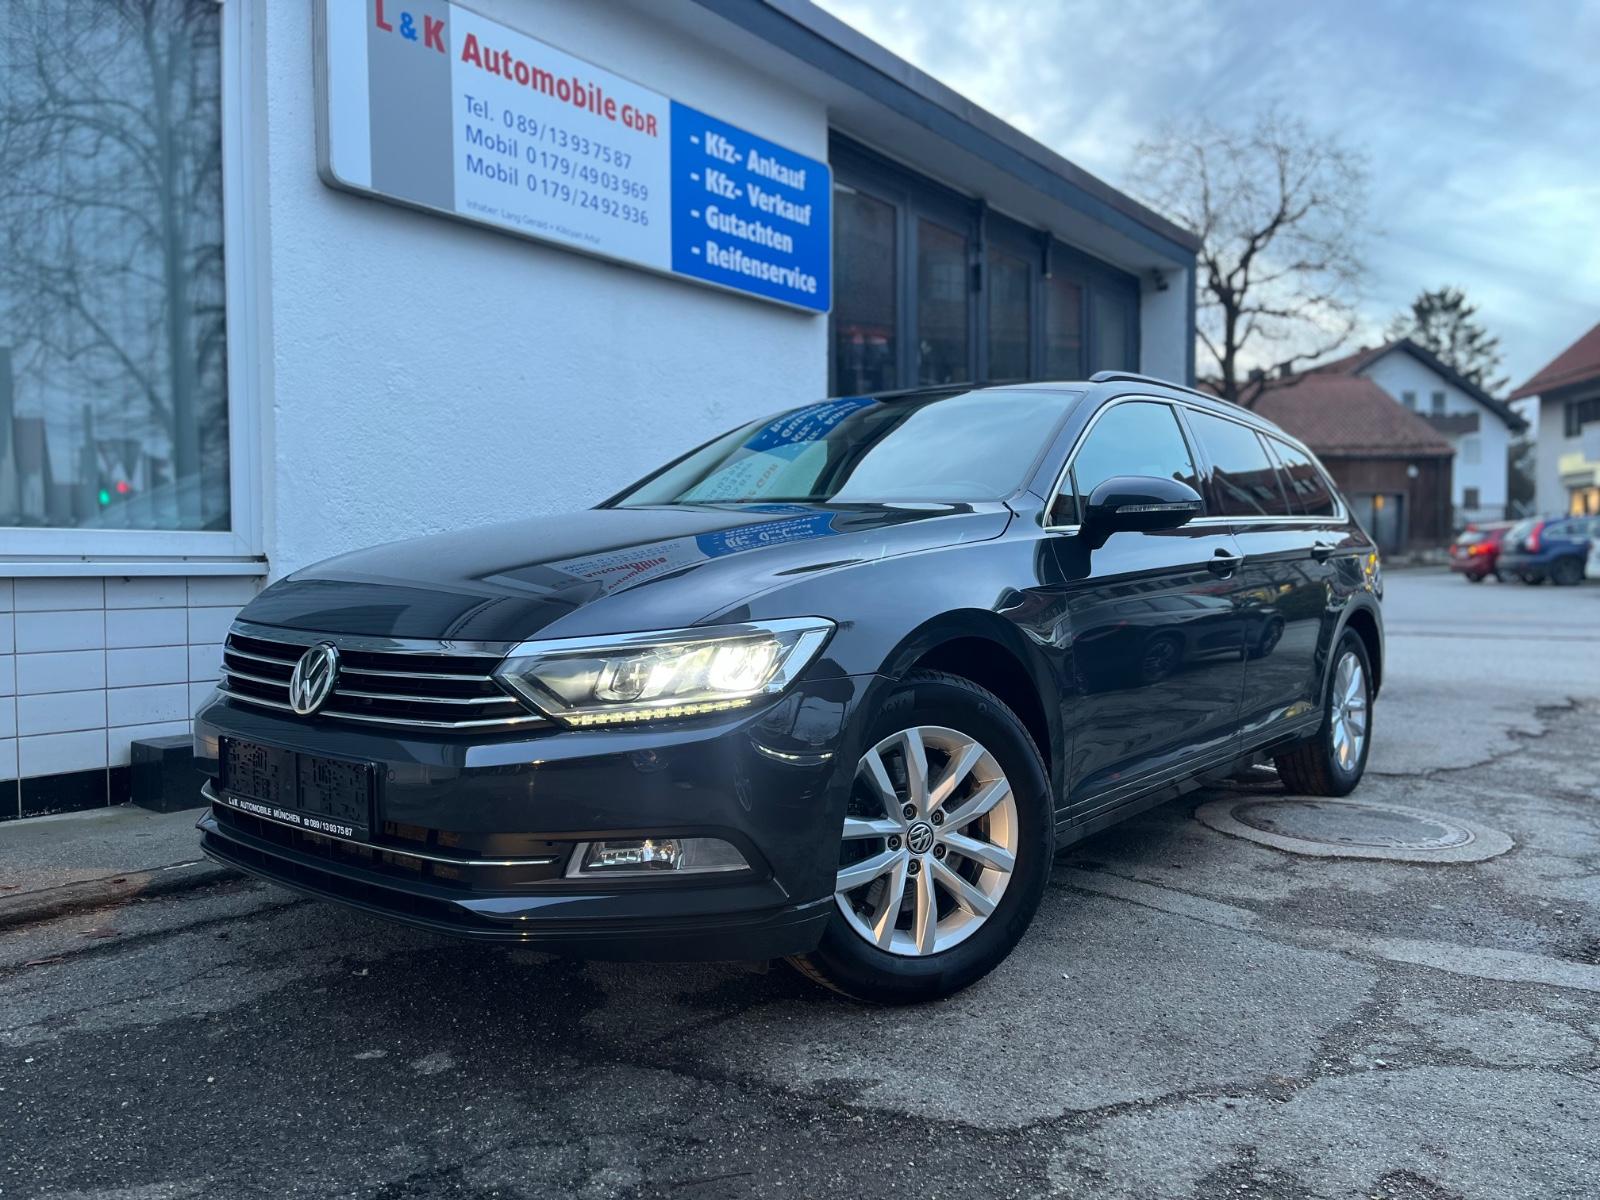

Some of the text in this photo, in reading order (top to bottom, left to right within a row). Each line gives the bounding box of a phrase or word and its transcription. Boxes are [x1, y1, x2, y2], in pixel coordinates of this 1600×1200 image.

[375, 0, 658, 138] L & K Automobile GbR
[464, 94, 495, 122] Tel.
[465, 124, 518, 158] Mobil
[705, 130, 743, 164] Kfz-
[746, 149, 806, 191] Ankauf
[466, 154, 519, 187] Mobil
[705, 167, 743, 200] Kfz-
[746, 183, 812, 226] Verkauf
[705, 205, 793, 254] Gutachten
[706, 240, 817, 294] Reifenservice
[240, 800, 272, 816] AUTOMOBILE
[273, 808, 301, 824] MÜNCHEN
